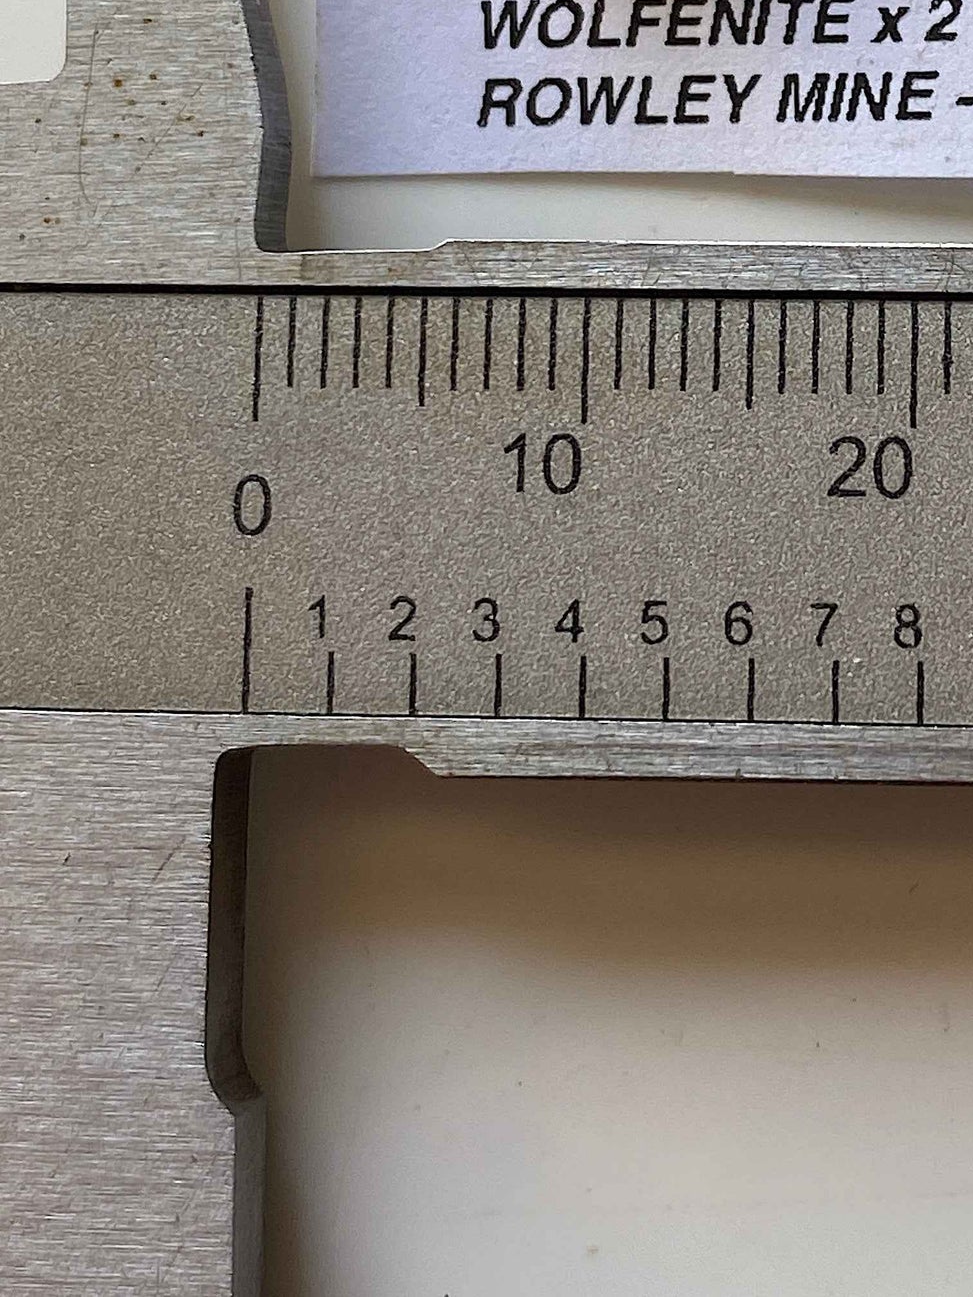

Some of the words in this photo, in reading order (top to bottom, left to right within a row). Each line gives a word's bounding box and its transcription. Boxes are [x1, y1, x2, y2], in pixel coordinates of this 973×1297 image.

[870, 6, 907, 44] x
[476, 73, 762, 128] ROWLEY
[775, 70, 940, 123] MINE
[232, 474, 272, 537] 0
[503, 432, 582, 495] 10
[826, 435, 914, 500] 20
[308, 594, 326, 639] 1
[388, 595, 417, 642] 2
[472, 597, 501, 643] 3
[554, 598, 584, 644] 4
[640, 600, 669, 645] 5
[724, 600, 753, 647] 6
[810, 602, 839, 648] 7
[893, 603, 923, 649] 8
